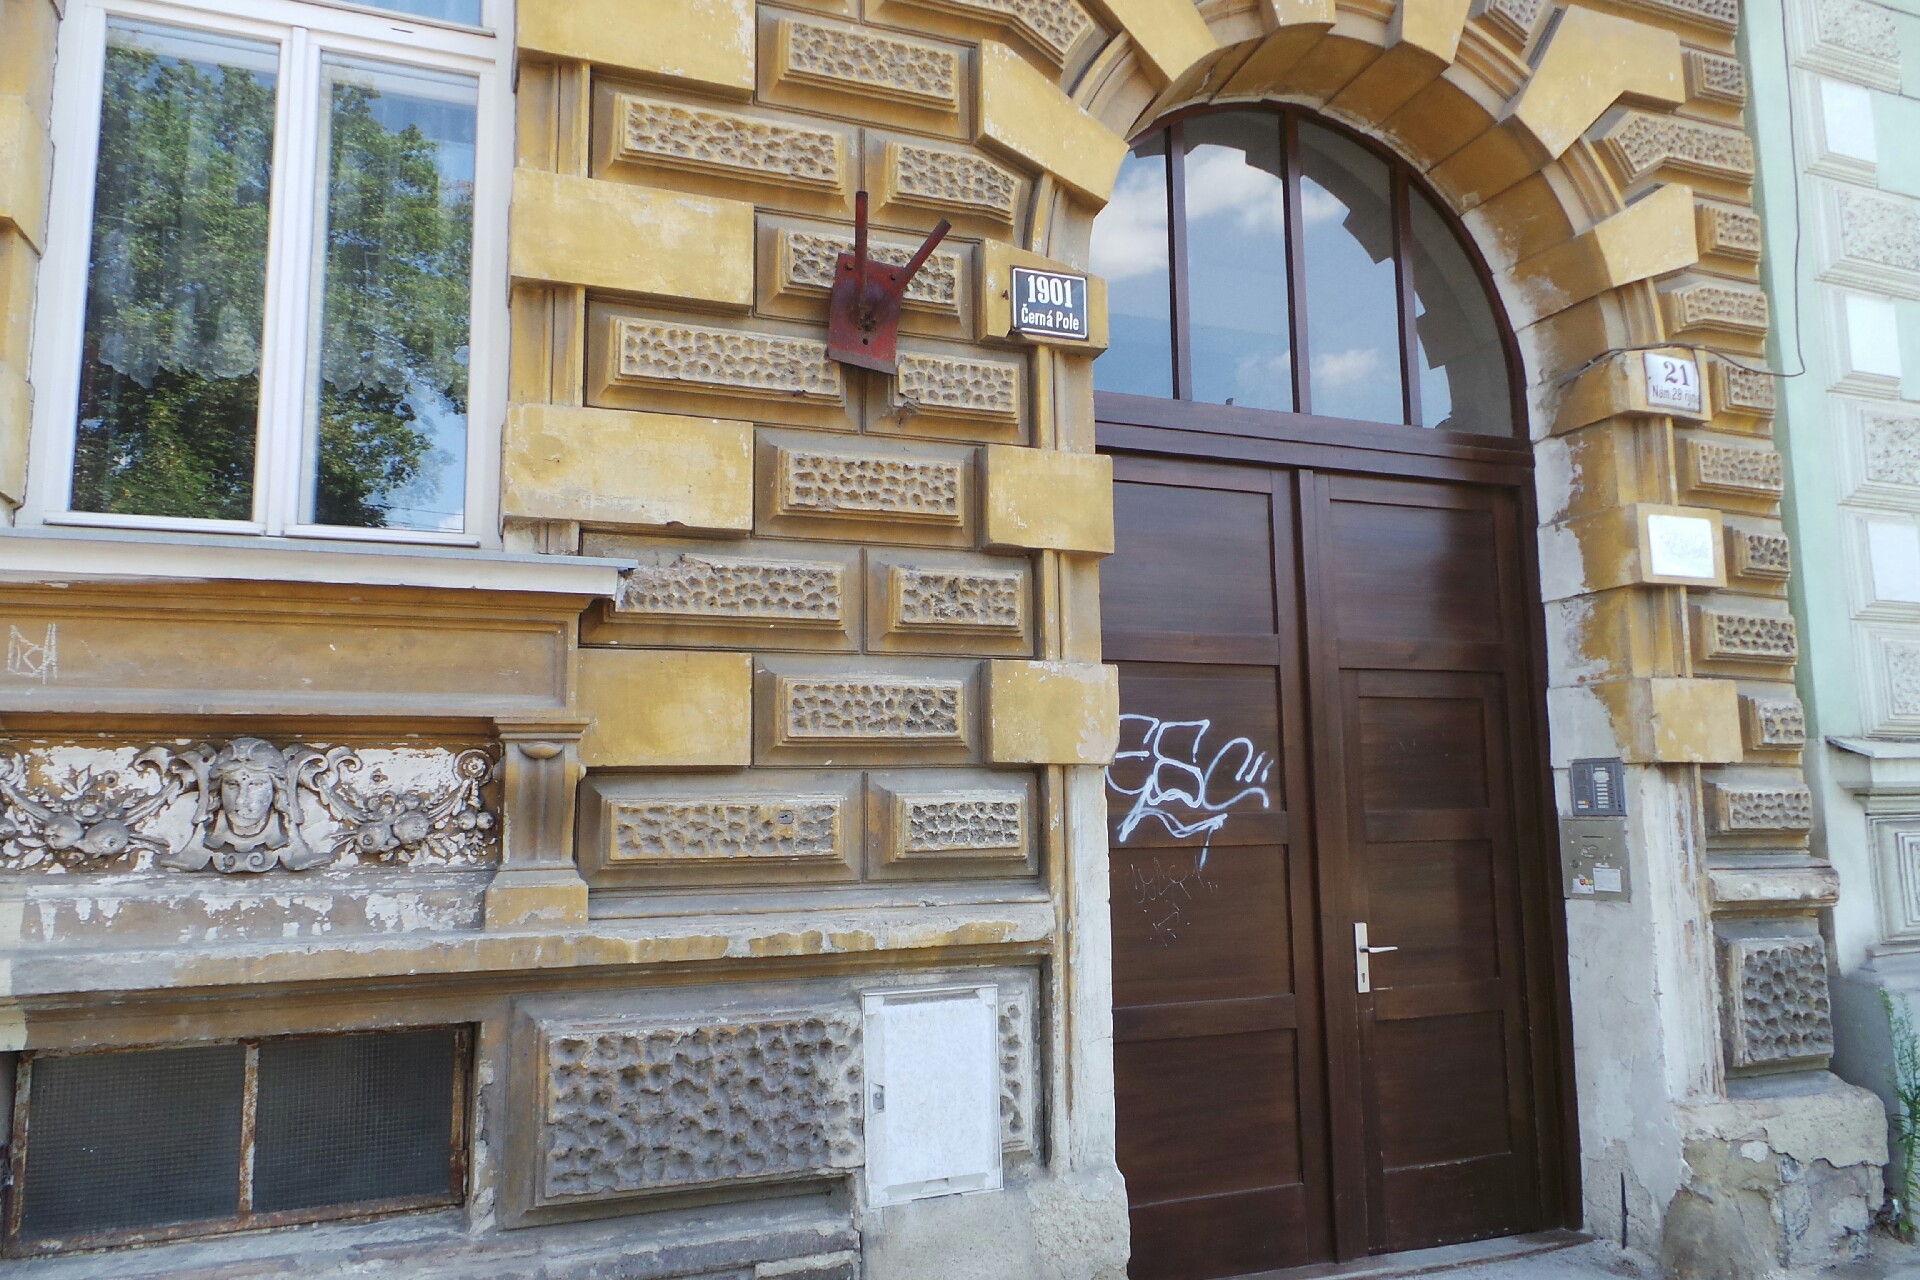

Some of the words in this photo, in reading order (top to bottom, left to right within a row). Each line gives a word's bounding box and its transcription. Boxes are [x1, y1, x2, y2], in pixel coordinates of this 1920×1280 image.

[1027, 274, 1073, 308] 1901
[1021, 303, 1054, 328] Černá
[1056, 311, 1080, 331] Pole
[1663, 361, 1690, 386] 21
